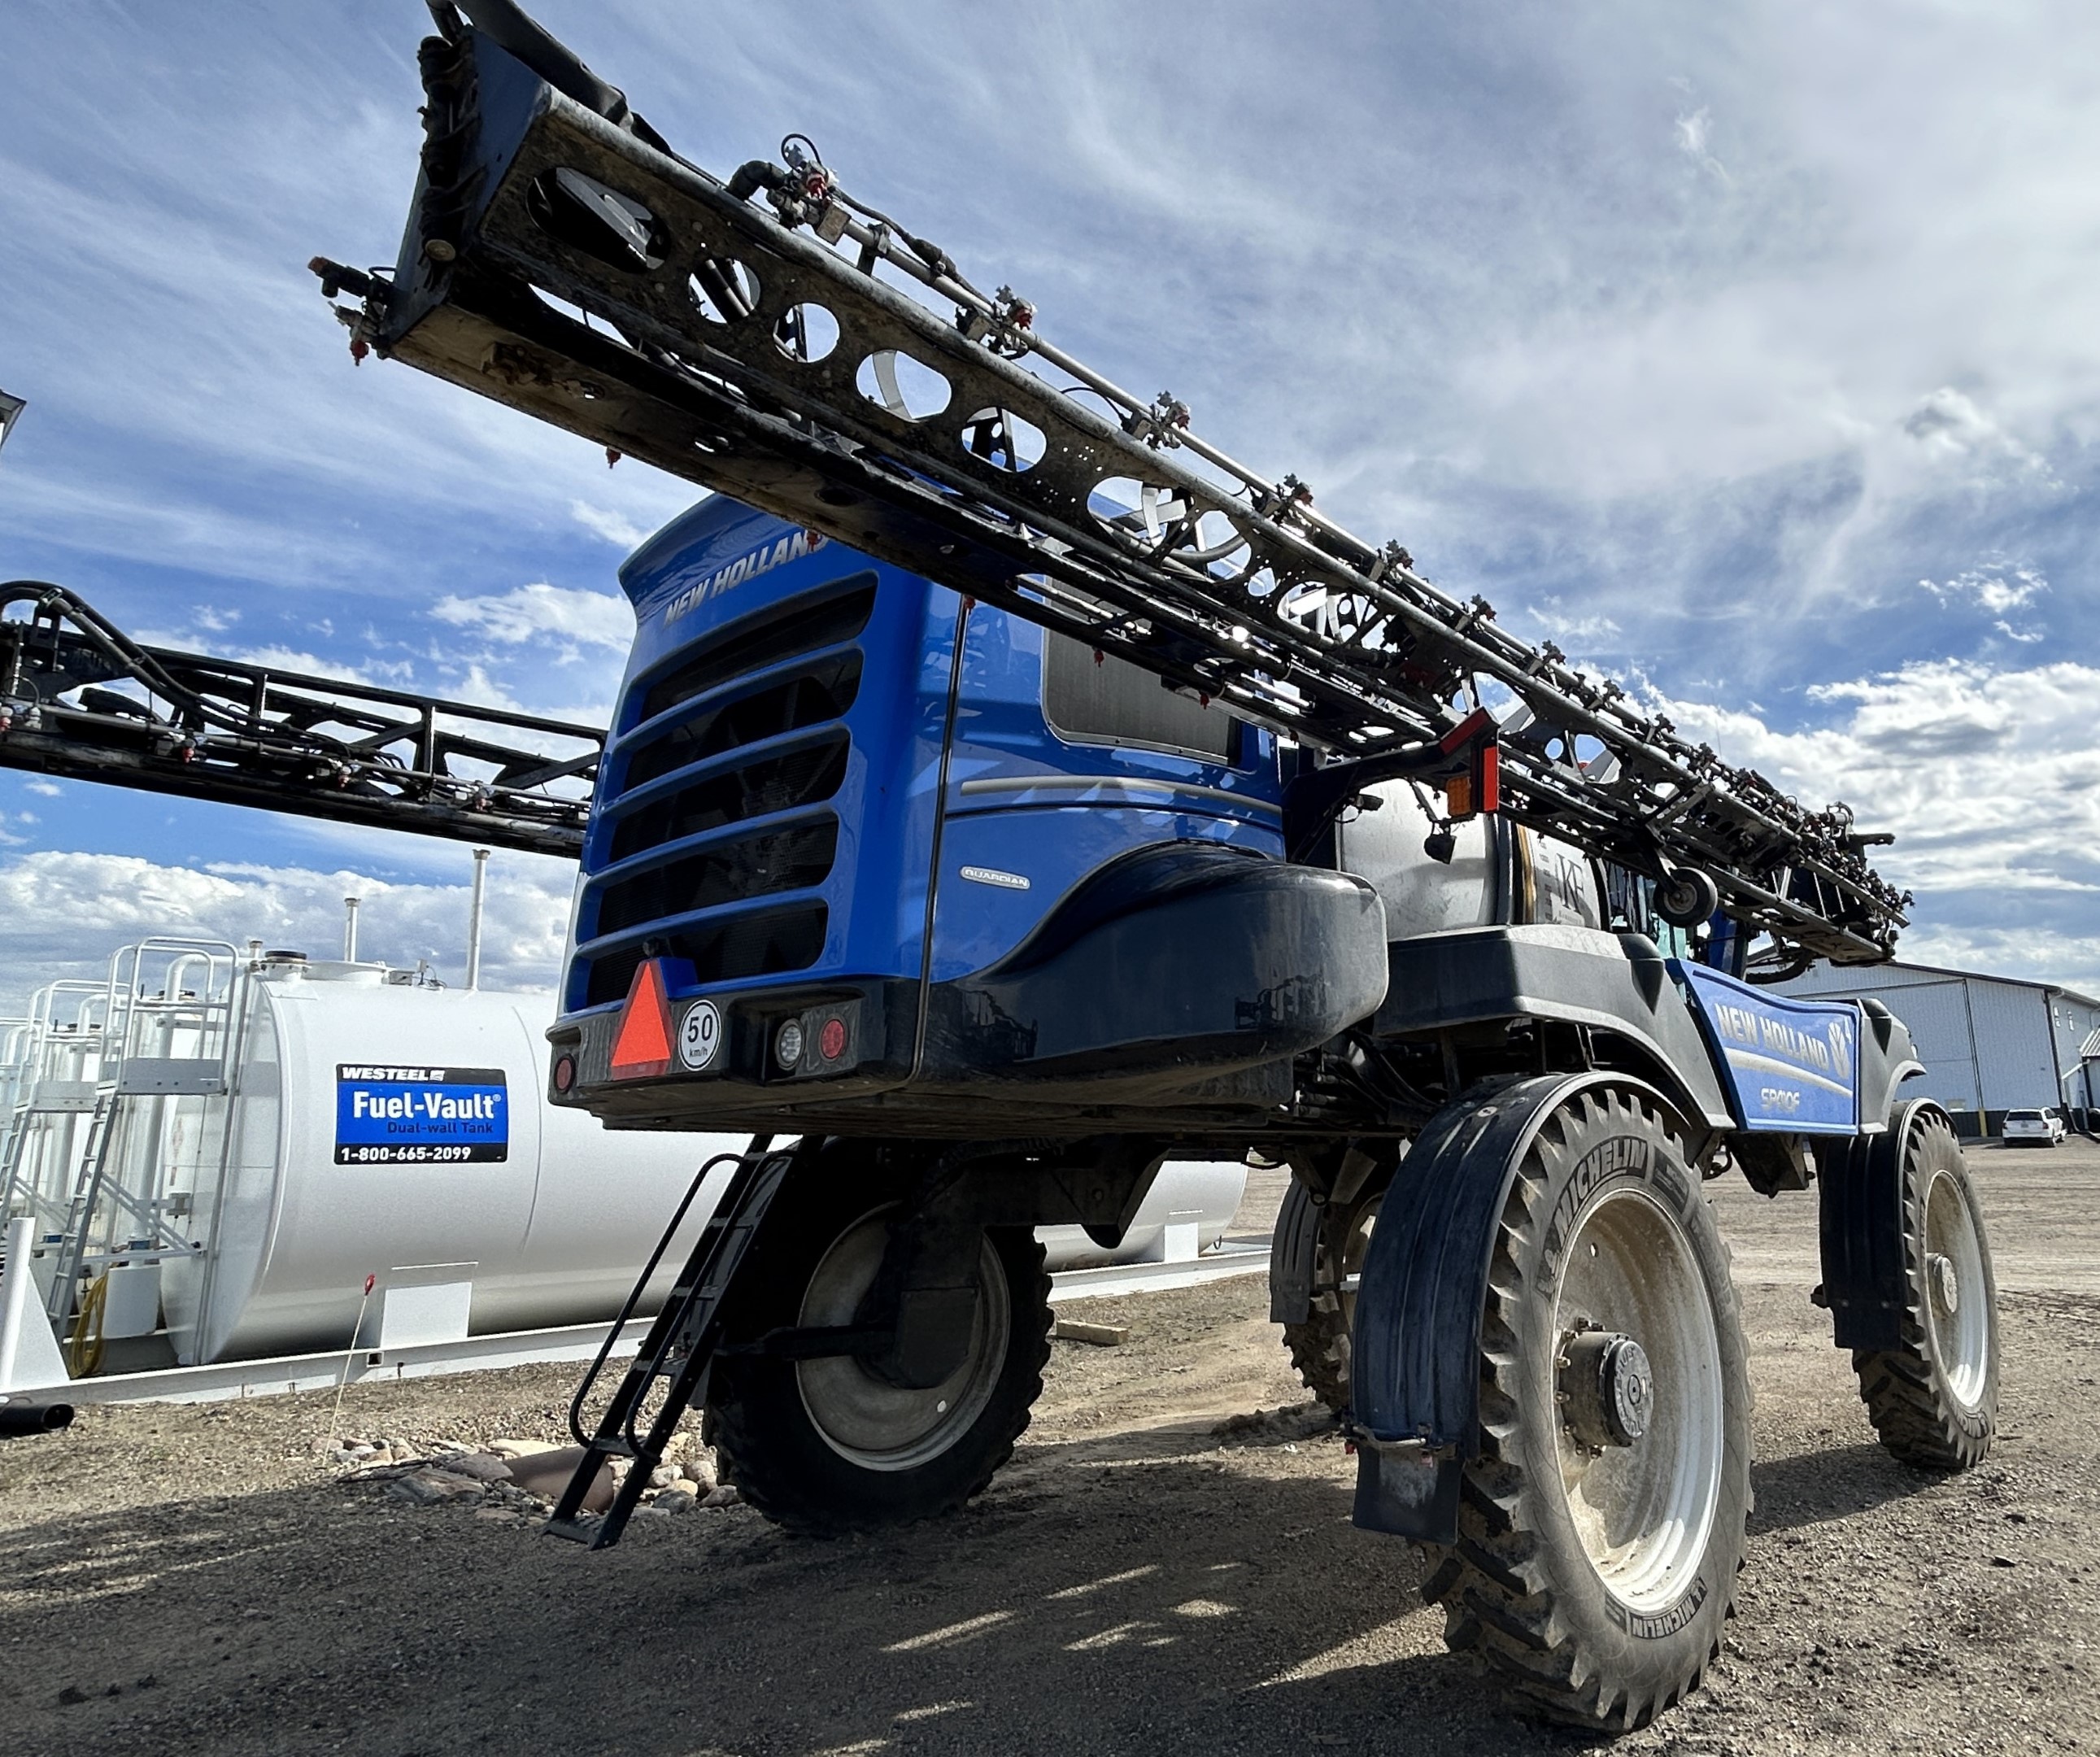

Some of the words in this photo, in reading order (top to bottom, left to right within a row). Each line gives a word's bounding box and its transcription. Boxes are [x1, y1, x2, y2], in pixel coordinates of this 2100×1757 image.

[664, 578, 711, 626] NEW
[965, 869, 1028, 887] GUARDIAN
[687, 1014, 712, 1043] 50
[1714, 1003, 1758, 1046] NEW
[1759, 1016, 1829, 1071] HOLLAND
[689, 1046, 708, 1057] km/h
[342, 1067, 429, 1081] WESTEEL
[387, 1122, 457, 1134] Dual-wall
[461, 1123, 494, 1134] Tank
[341, 1147, 472, 1161] 1-800-665-2099
[1553, 1139, 1647, 1247] MICHELIN
[1632, 1594, 1697, 1638] MICHELIN
